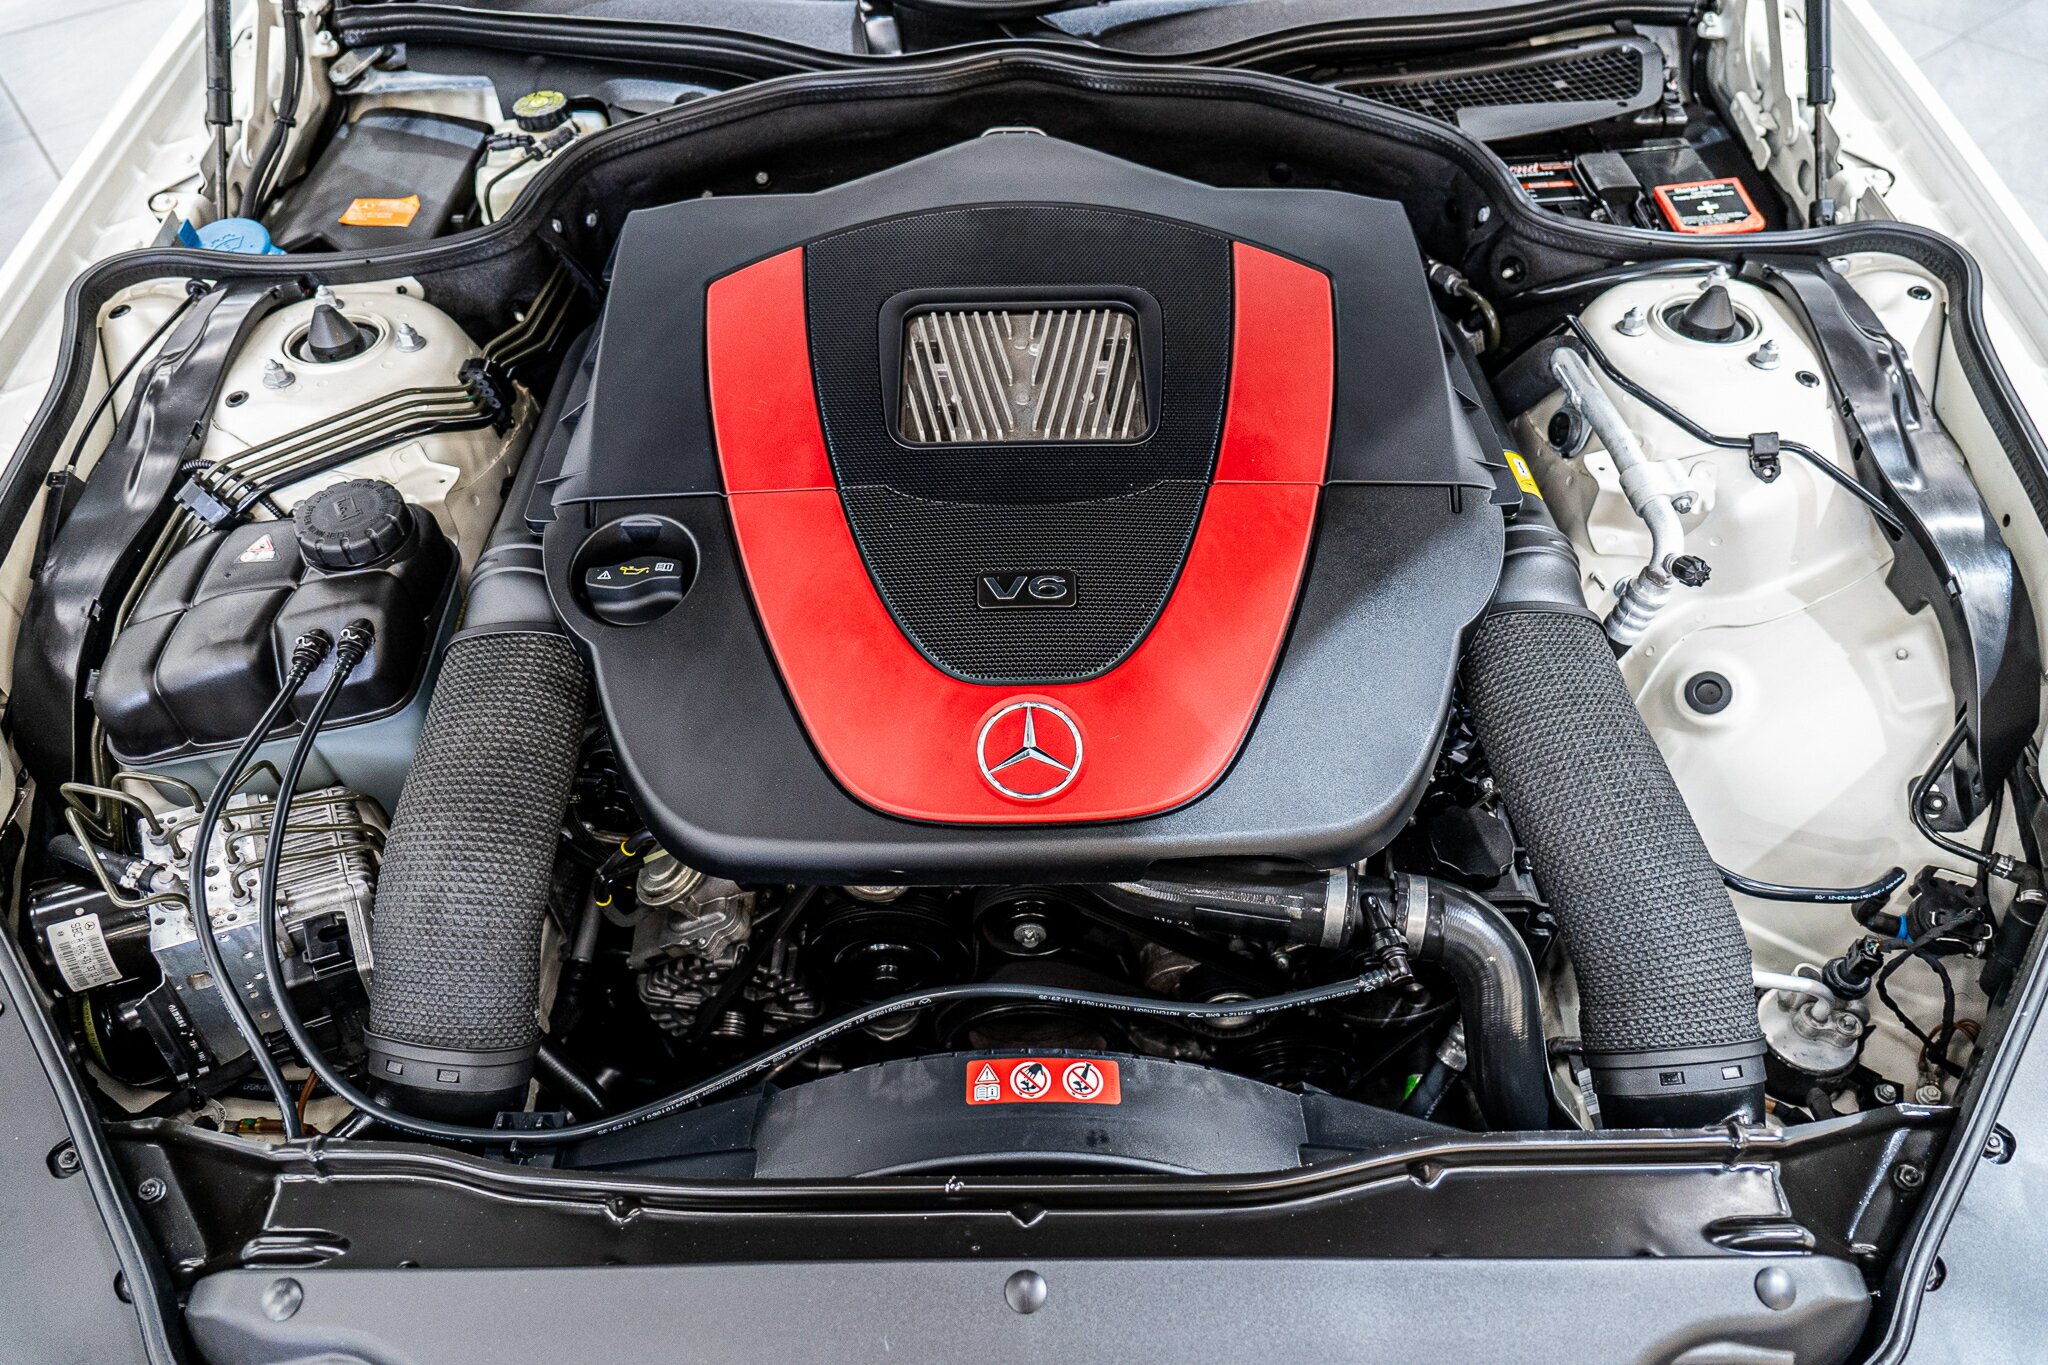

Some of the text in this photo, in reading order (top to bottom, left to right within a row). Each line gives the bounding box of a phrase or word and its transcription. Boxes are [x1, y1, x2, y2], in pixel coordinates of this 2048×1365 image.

[983, 575, 1067, 600] V6
[70, 922, 84, 938] SBC
[702, 1072, 748, 1096] HUTCHINSON
